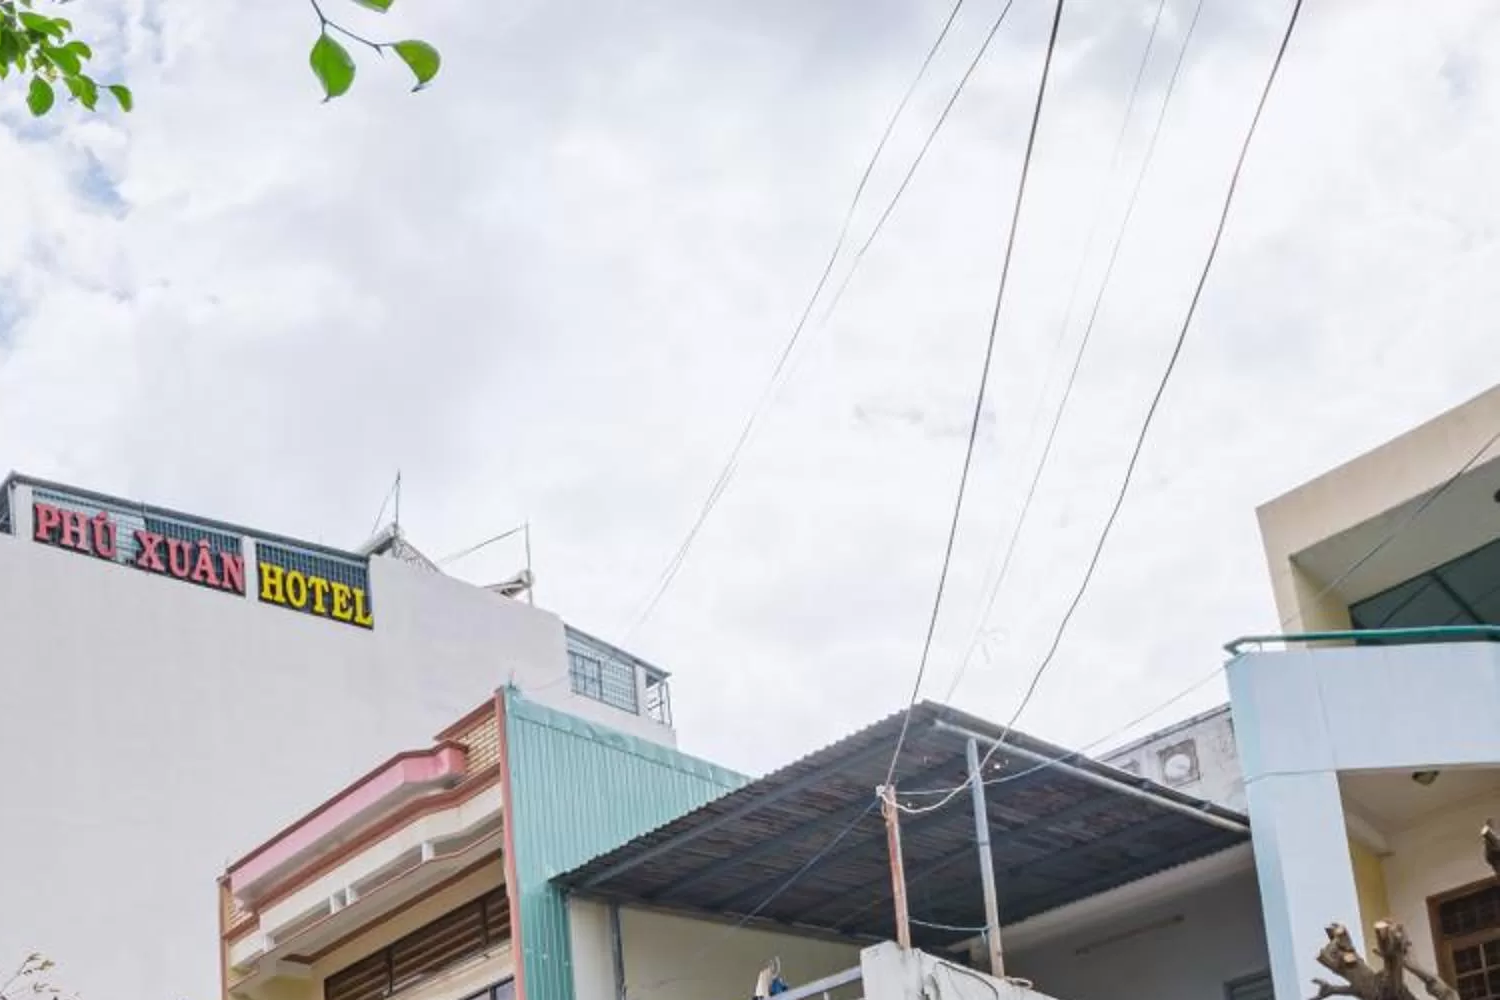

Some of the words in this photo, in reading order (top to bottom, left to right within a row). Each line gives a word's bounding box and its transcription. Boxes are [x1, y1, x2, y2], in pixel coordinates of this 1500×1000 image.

[34, 503, 116, 558] PHÚ
[134, 530, 244, 593] XUÂN
[260, 562, 373, 627] HOTEL
